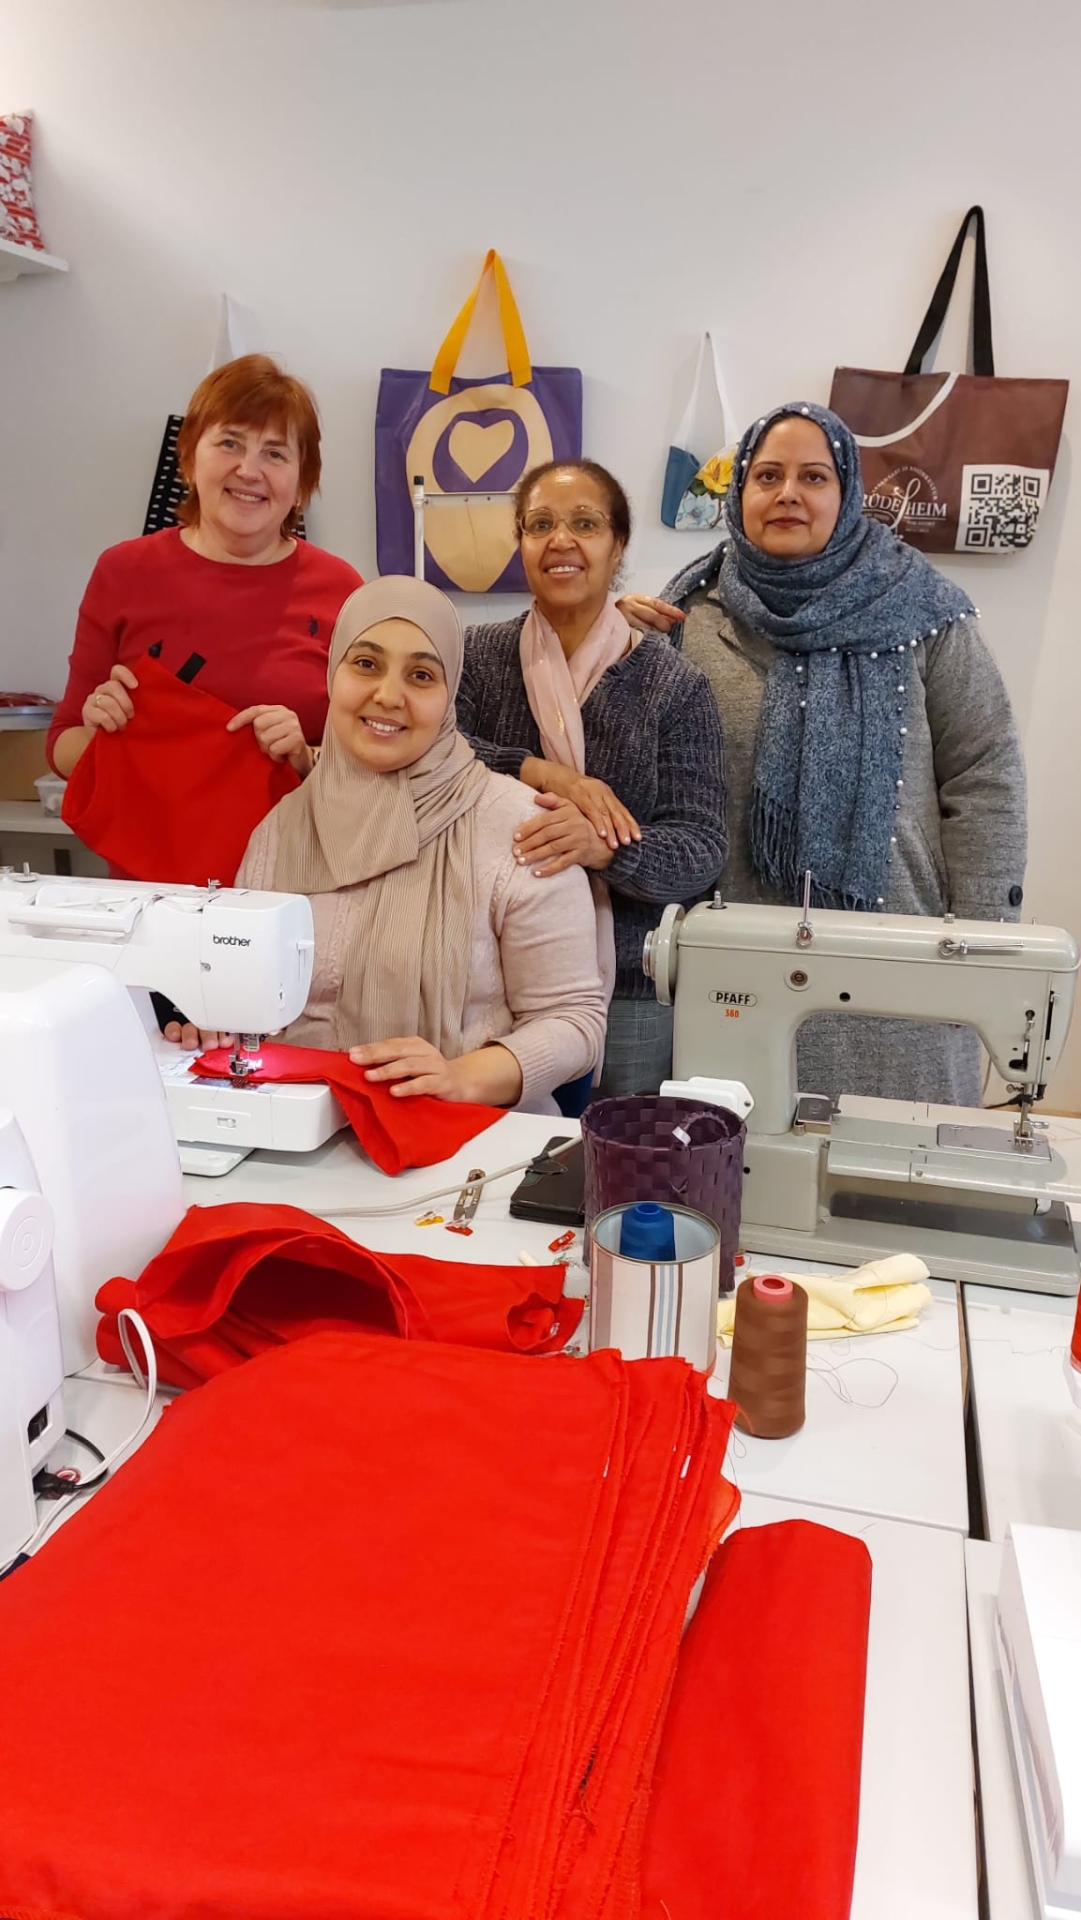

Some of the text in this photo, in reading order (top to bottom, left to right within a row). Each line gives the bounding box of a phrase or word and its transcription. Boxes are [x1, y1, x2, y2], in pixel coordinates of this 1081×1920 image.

[213, 934, 251, 947] brother
[716, 992, 750, 1004] PFAFF
[725, 1008, 739, 1018] 360
